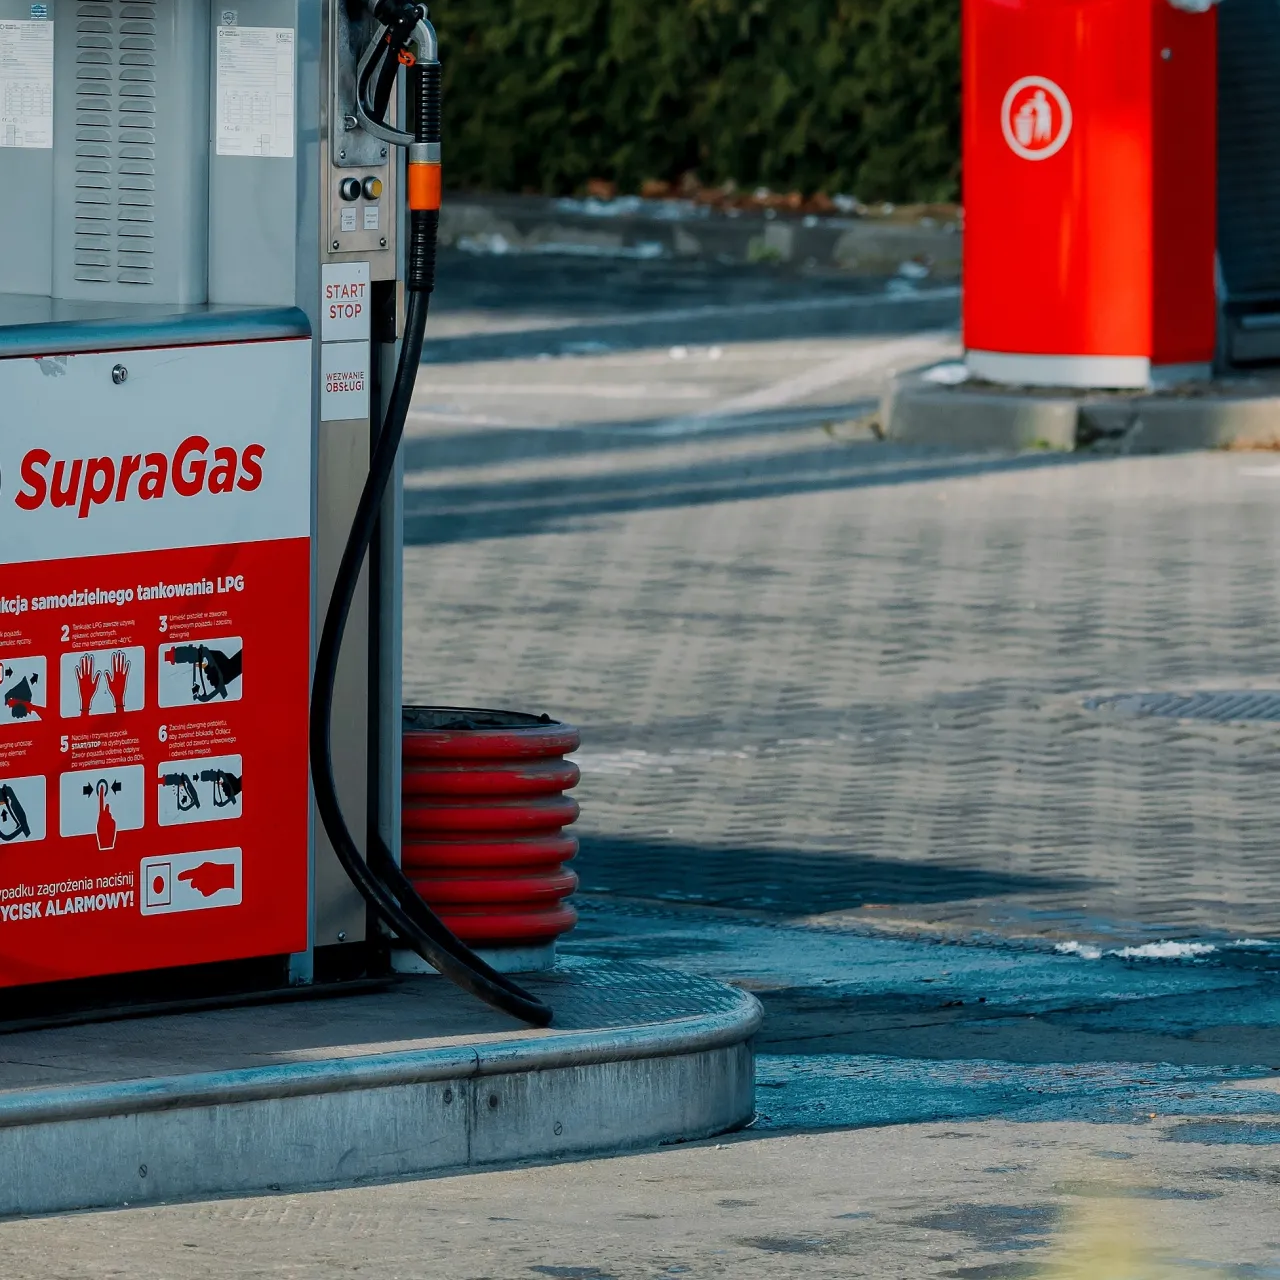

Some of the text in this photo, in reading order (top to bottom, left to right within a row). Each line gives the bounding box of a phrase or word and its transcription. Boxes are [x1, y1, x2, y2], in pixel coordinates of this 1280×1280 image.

[326, 283, 365, 299] START
[330, 304, 362, 319] STOP
[326, 372, 364, 381] WEZWANIE
[326, 381, 364, 392] OBSŁUGI
[14, 435, 266, 519] SupraGas
[31, 585, 133, 611] samodzielnego
[137, 580, 213, 601] tankowania
[217, 575, 244, 594] LPG
[159, 615, 167, 632] 3
[61, 625, 70, 642] 2
[158, 725, 167, 742] 6
[60, 735, 69, 752] 5
[71, 741, 101, 750] START/STOP
[37, 877, 93, 897] zagrożenia
[95, 871, 134, 889] naciśnij
[45, 891, 134, 917] ALARMOWY!
